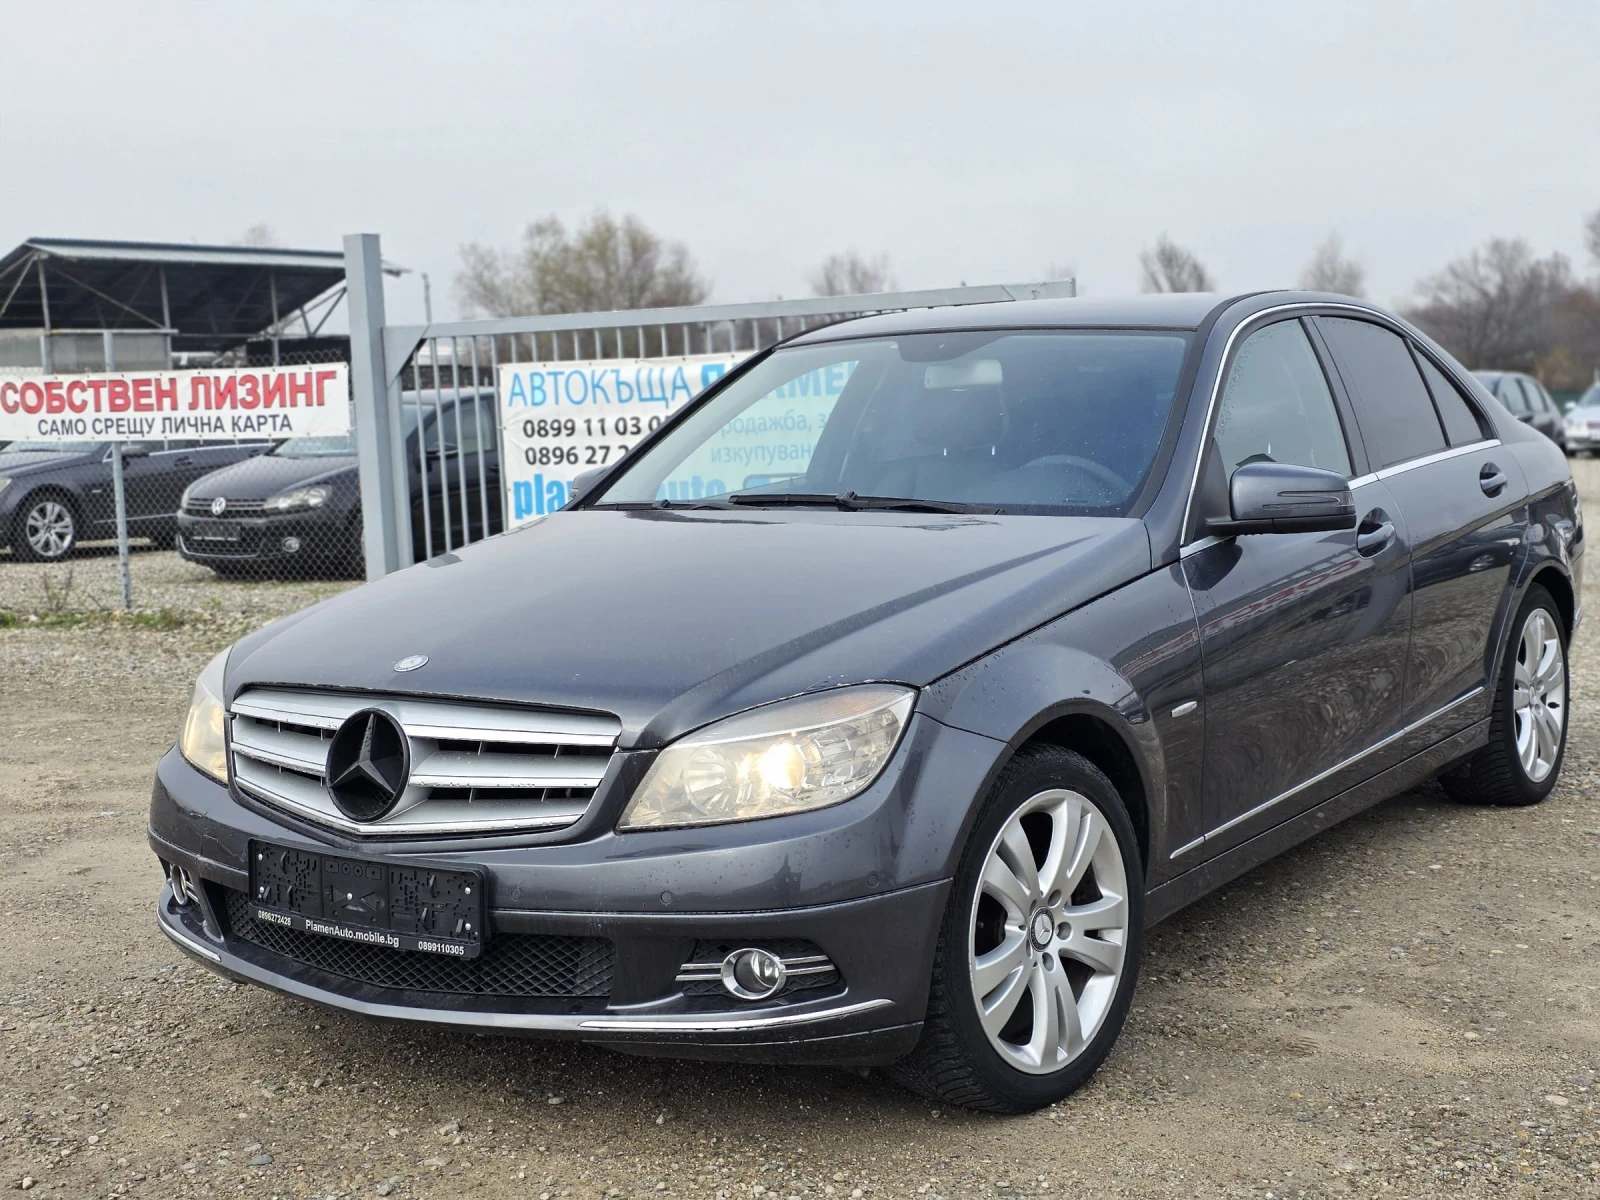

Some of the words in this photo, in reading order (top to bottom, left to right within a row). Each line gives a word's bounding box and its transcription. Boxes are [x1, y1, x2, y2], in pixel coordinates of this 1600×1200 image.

[0, 378, 179, 414] СОБСТВЕН
[188, 370, 337, 411] ЛИЗИНГ
[508, 366, 694, 409] АВТОКЪЩА
[37, 418, 87, 436] САМО
[92, 417, 155, 438] СРЕЩУ
[161, 416, 225, 434] ЛИЧНА
[232, 414, 293, 432] КАРТА
[523, 418, 576, 438] 0899
[584, 417, 607, 437] 11
[615, 416, 642, 436] 03
[648, 415, 672, 433] 0
[719, 409, 813, 439] родажба,
[525, 446, 579, 466] 0896
[585, 445, 611, 465] 27
[305, 919, 400, 948] PlamenAuto.mobile.bg
[418, 940, 465, 955] 0899110305
